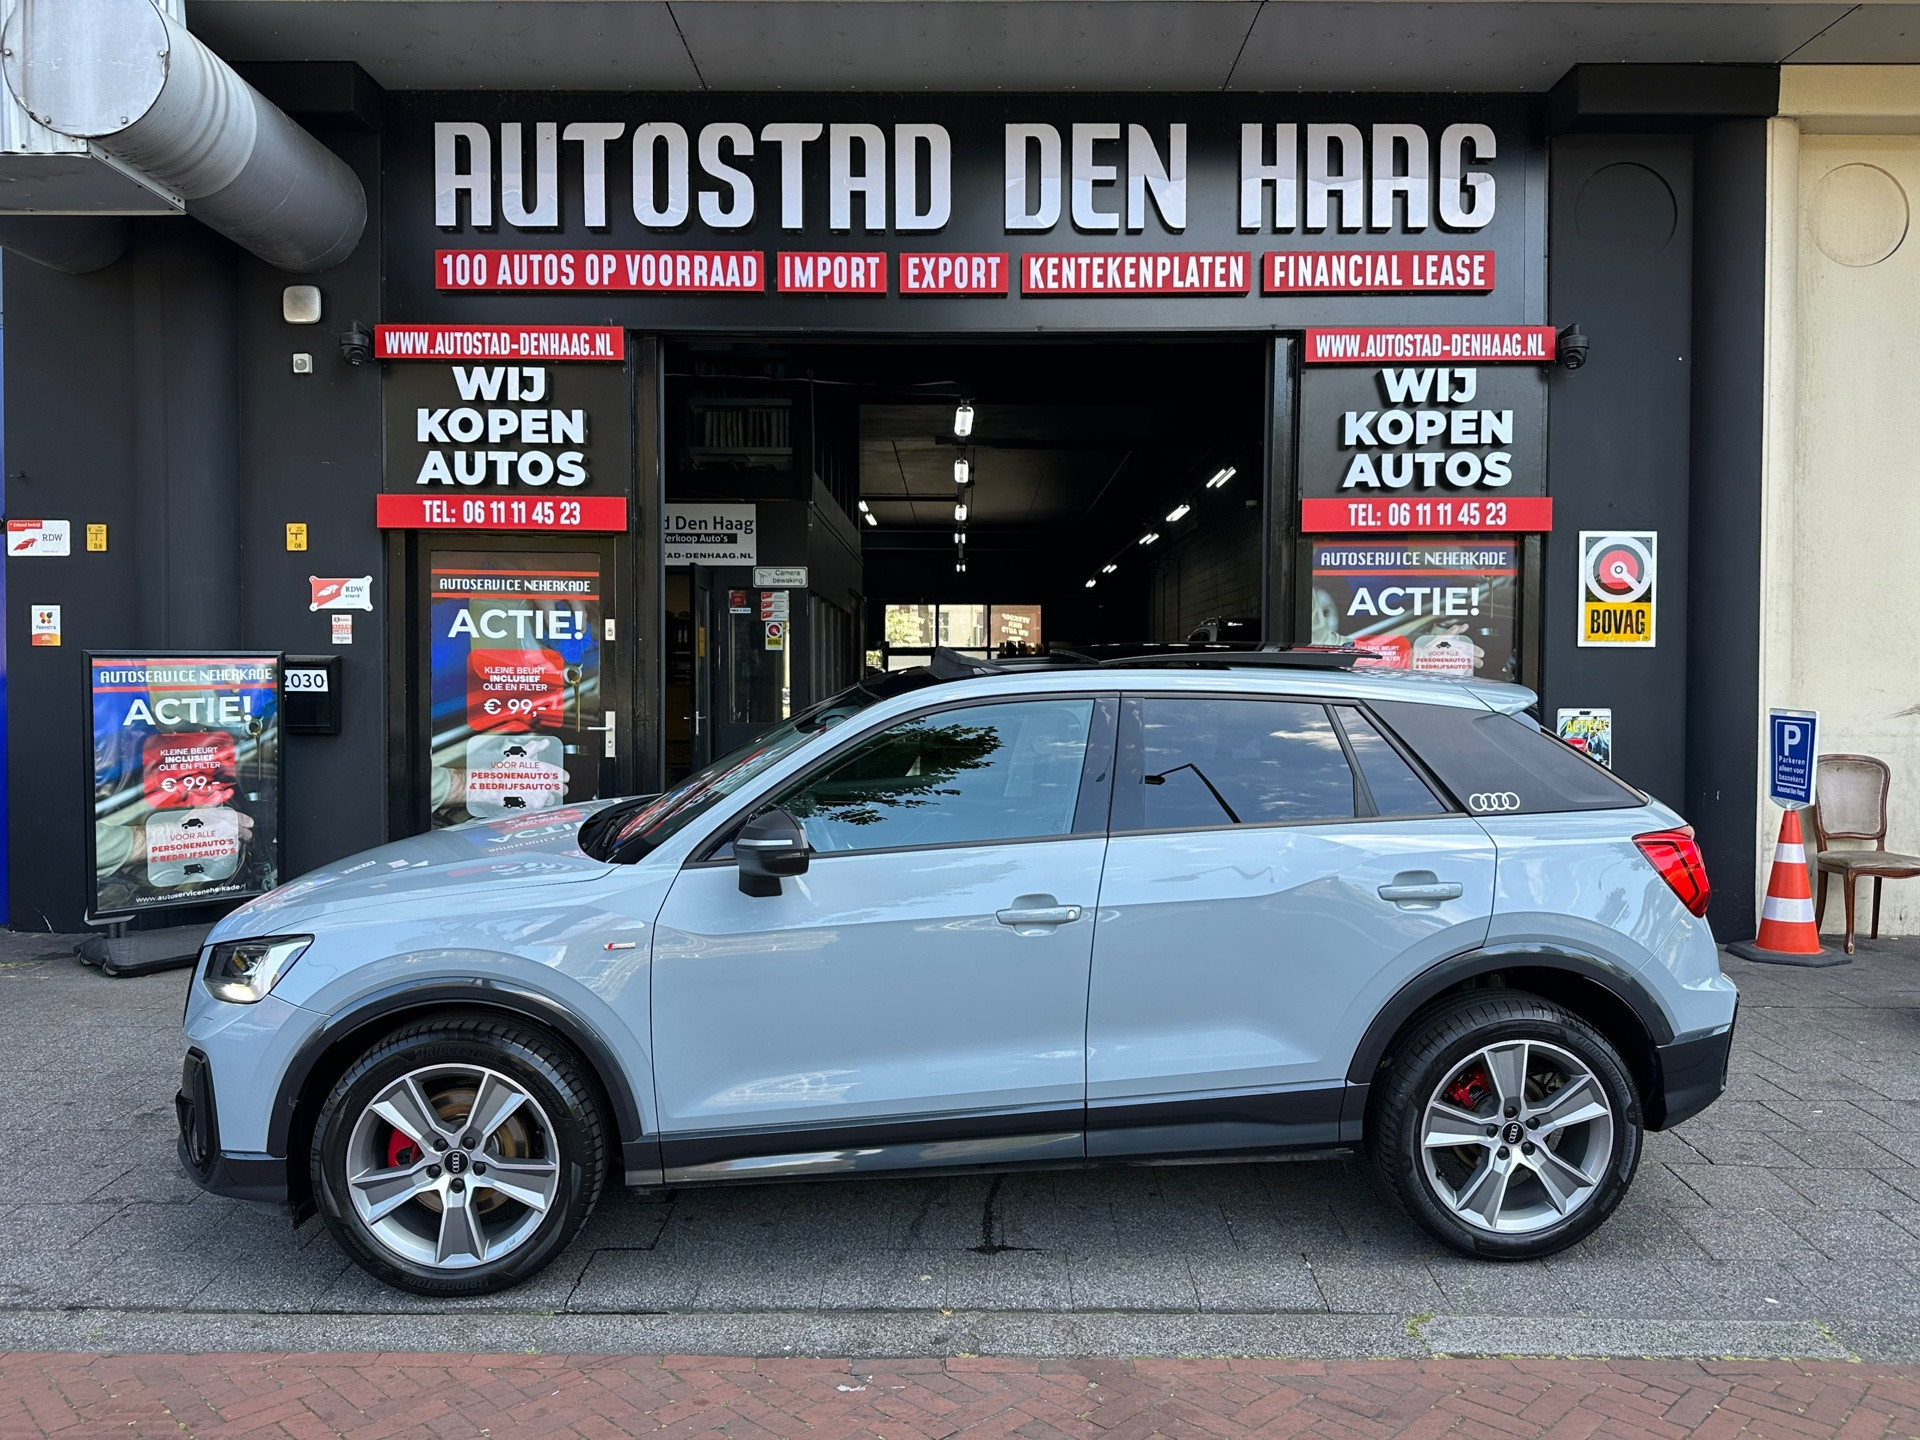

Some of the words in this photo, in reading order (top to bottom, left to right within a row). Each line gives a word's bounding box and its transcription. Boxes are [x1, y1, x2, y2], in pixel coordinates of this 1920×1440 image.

[434, 121, 951, 229] AUTOSTAD
[1004, 122, 1188, 229] DEN
[1240, 122, 1497, 229] HAAG
[442, 253, 487, 286] 100
[497, 253, 575, 286] AUTOS
[585, 254, 616, 287] OP
[626, 255, 758, 288] VOORRAAD
[783, 256, 880, 288] IMPORT
[908, 256, 1000, 289] EXPORT
[1029, 255, 1245, 289] KENTEKENPLATEN
[1273, 254, 1403, 288] FINANCIAL
[1412, 254, 1486, 287] LEASE
[385, 331, 614, 356] WWW.AUTOSTAD-DENHAAG.NL
[1316, 333, 1546, 358] WWW.AUTOSTAD-DENHAAG.NL
[452, 366, 546, 402] WIJ
[1381, 367, 1477, 403] WIJ
[417, 407, 584, 443] KOPEN
[1344, 409, 1513, 446] KOPEN
[416, 450, 586, 486] AUTOS
[1342, 451, 1513, 488] AUTOS
[422, 500, 456, 522] TEL:
[463, 500, 484, 523] 06
[490, 500, 506, 523] 11
[511, 501, 526, 523] 11
[531, 501, 554, 524] 45
[559, 501, 581, 525] 23
[1348, 503, 1382, 526] TEL:
[1388, 502, 1410, 526] 06
[1416, 502, 1431, 525] 11
[1437, 502, 1452, 525] 11
[1457, 502, 1480, 525] 45
[1486, 502, 1507, 525] 23
[675, 515, 708, 530] Den
[713, 515, 754, 535] Haag
[42, 533, 63, 542] RDW
[700, 534, 728, 543] Auto's
[1320, 551, 1421, 566] AUTOSERVICE
[1424, 551, 1507, 566] NEHERKADE
[772, 577, 803, 585] bewaking
[775, 569, 800, 577] Camera
[345, 585, 364, 593] RDW
[439, 578, 521, 591] AUTOSERVICE
[524, 579, 591, 593] NEHERKADE
[1346, 587, 1480, 617] ACTIE!
[447, 608, 584, 640] ACTIE!
[1590, 608, 1646, 634] BOVAG
[100, 669, 196, 684] AUTOSERVICE
[200, 668, 272, 682] NEHERKADE
[484, 666, 515, 674] KLEINE
[517, 666, 546, 675] BEURT
[489, 675, 541, 683] INCLUSIEF
[483, 683, 504, 691] OLIE
[505, 683, 517, 691] EN
[519, 683, 548, 692] FILTER
[123, 695, 252, 726] ACTIE!
[483, 698, 502, 715] €
[507, 698, 547, 718] 99,-
[1784, 724, 1801, 757] P
[160, 748, 189, 756] KLEINE
[190, 746, 218, 755] BEURT
[165, 754, 215, 764] INCLUSIEF
[1778, 755, 1806, 765] Parkeren
[159, 763, 178, 771] OLIE
[180, 762, 192, 770] EN
[194, 761, 221, 769] FILTER
[490, 761, 517, 769] VOOR
[519, 761, 540, 769] ALLE
[1778, 764, 1792, 773] alleen
[1793, 767, 1805, 775] voor
[160, 777, 178, 793] €
[183, 775, 221, 792] 99,-
[471, 772, 559, 780] PERSONENAUTO'S
[1778, 772, 1804, 784] bezoekers
[469, 782, 477, 790] &
[479, 783, 560, 791] BEDRIJFSAUTO'S
[169, 832, 195, 841] VOOR
[197, 829, 216, 838] ALLE
[151, 838, 234, 853] PERSONENAUTO'S
[159, 847, 236, 862] BEDRIJFSAUTO'S
